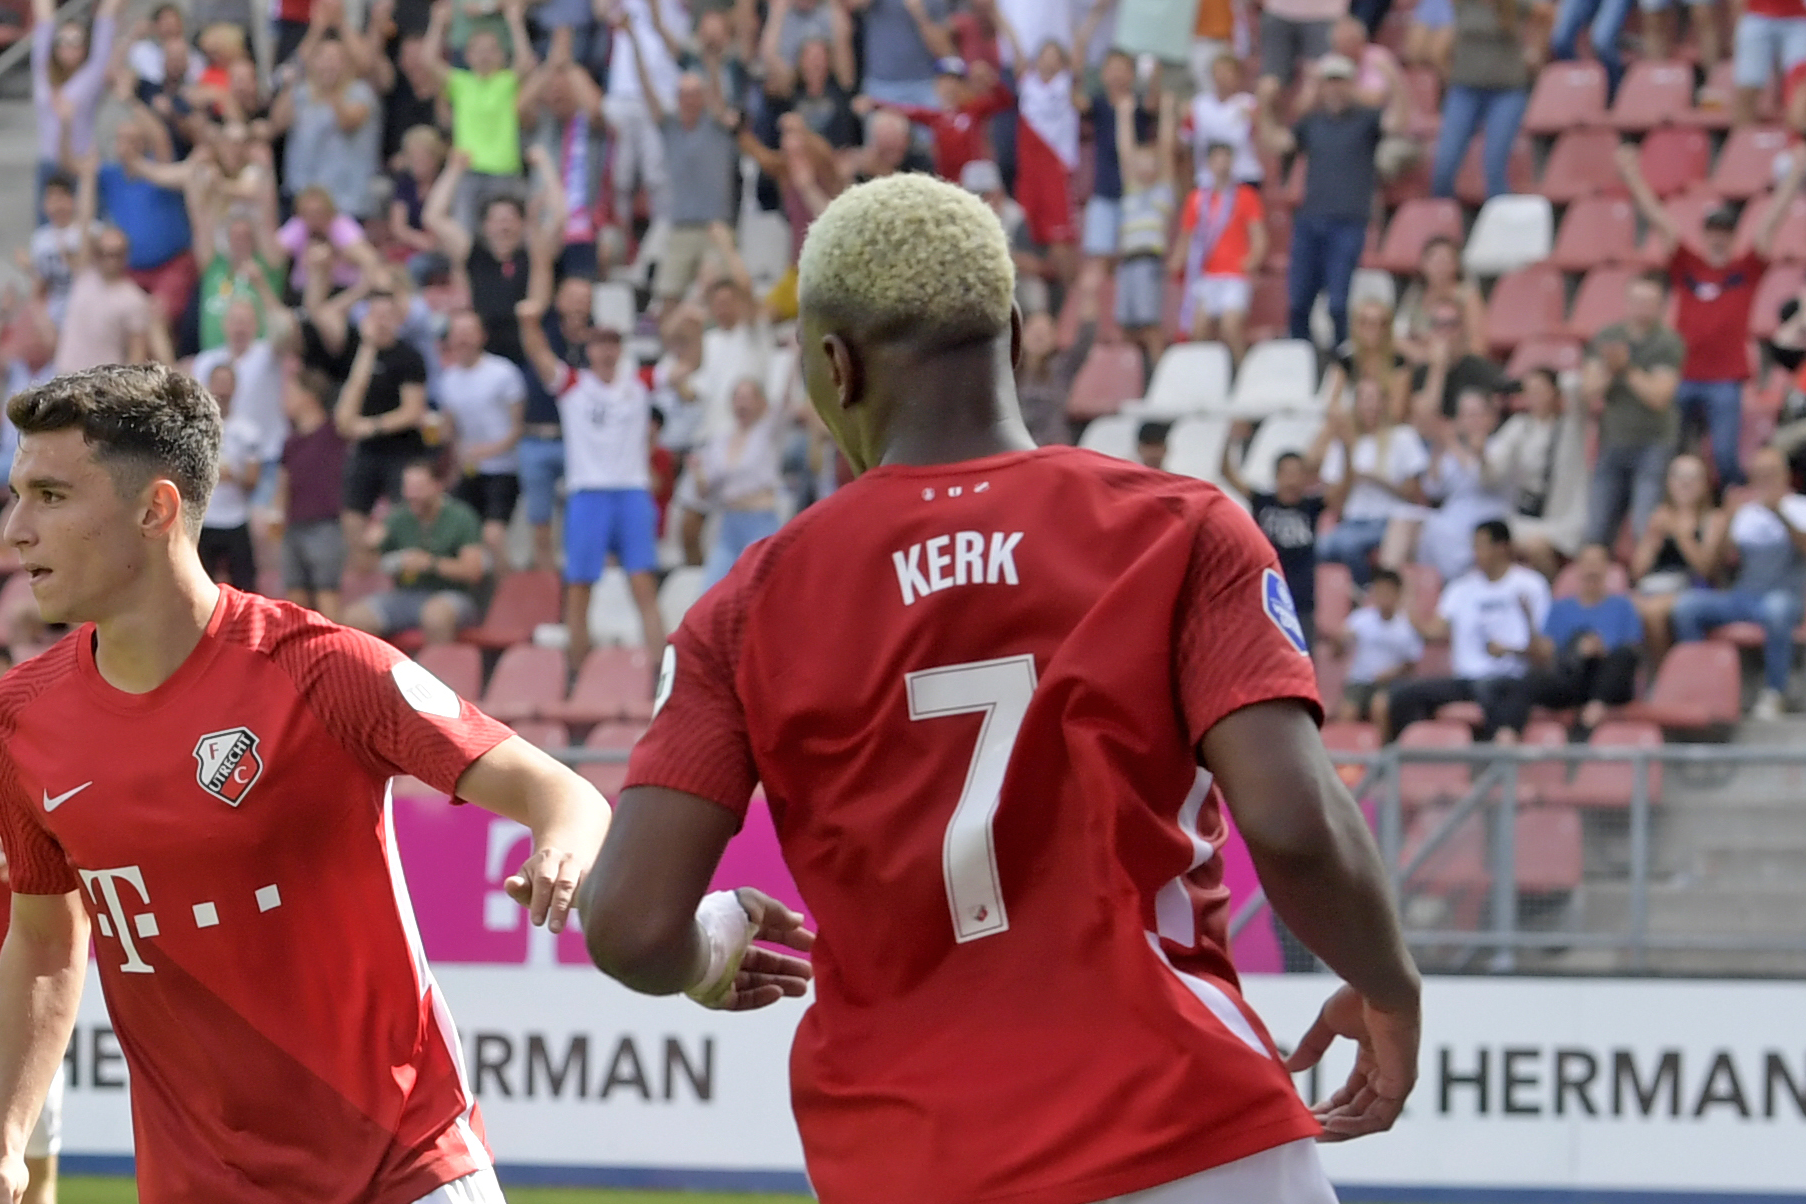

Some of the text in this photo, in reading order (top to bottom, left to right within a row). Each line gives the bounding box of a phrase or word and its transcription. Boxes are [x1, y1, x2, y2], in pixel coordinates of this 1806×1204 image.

[893, 530, 1024, 605] KERK
[207, 733, 252, 793] UTRECHT
[208, 741, 220, 761] F
[233, 765, 250, 784] C
[904, 653, 1038, 944] 7
[460, 1031, 714, 1102] RMAN
